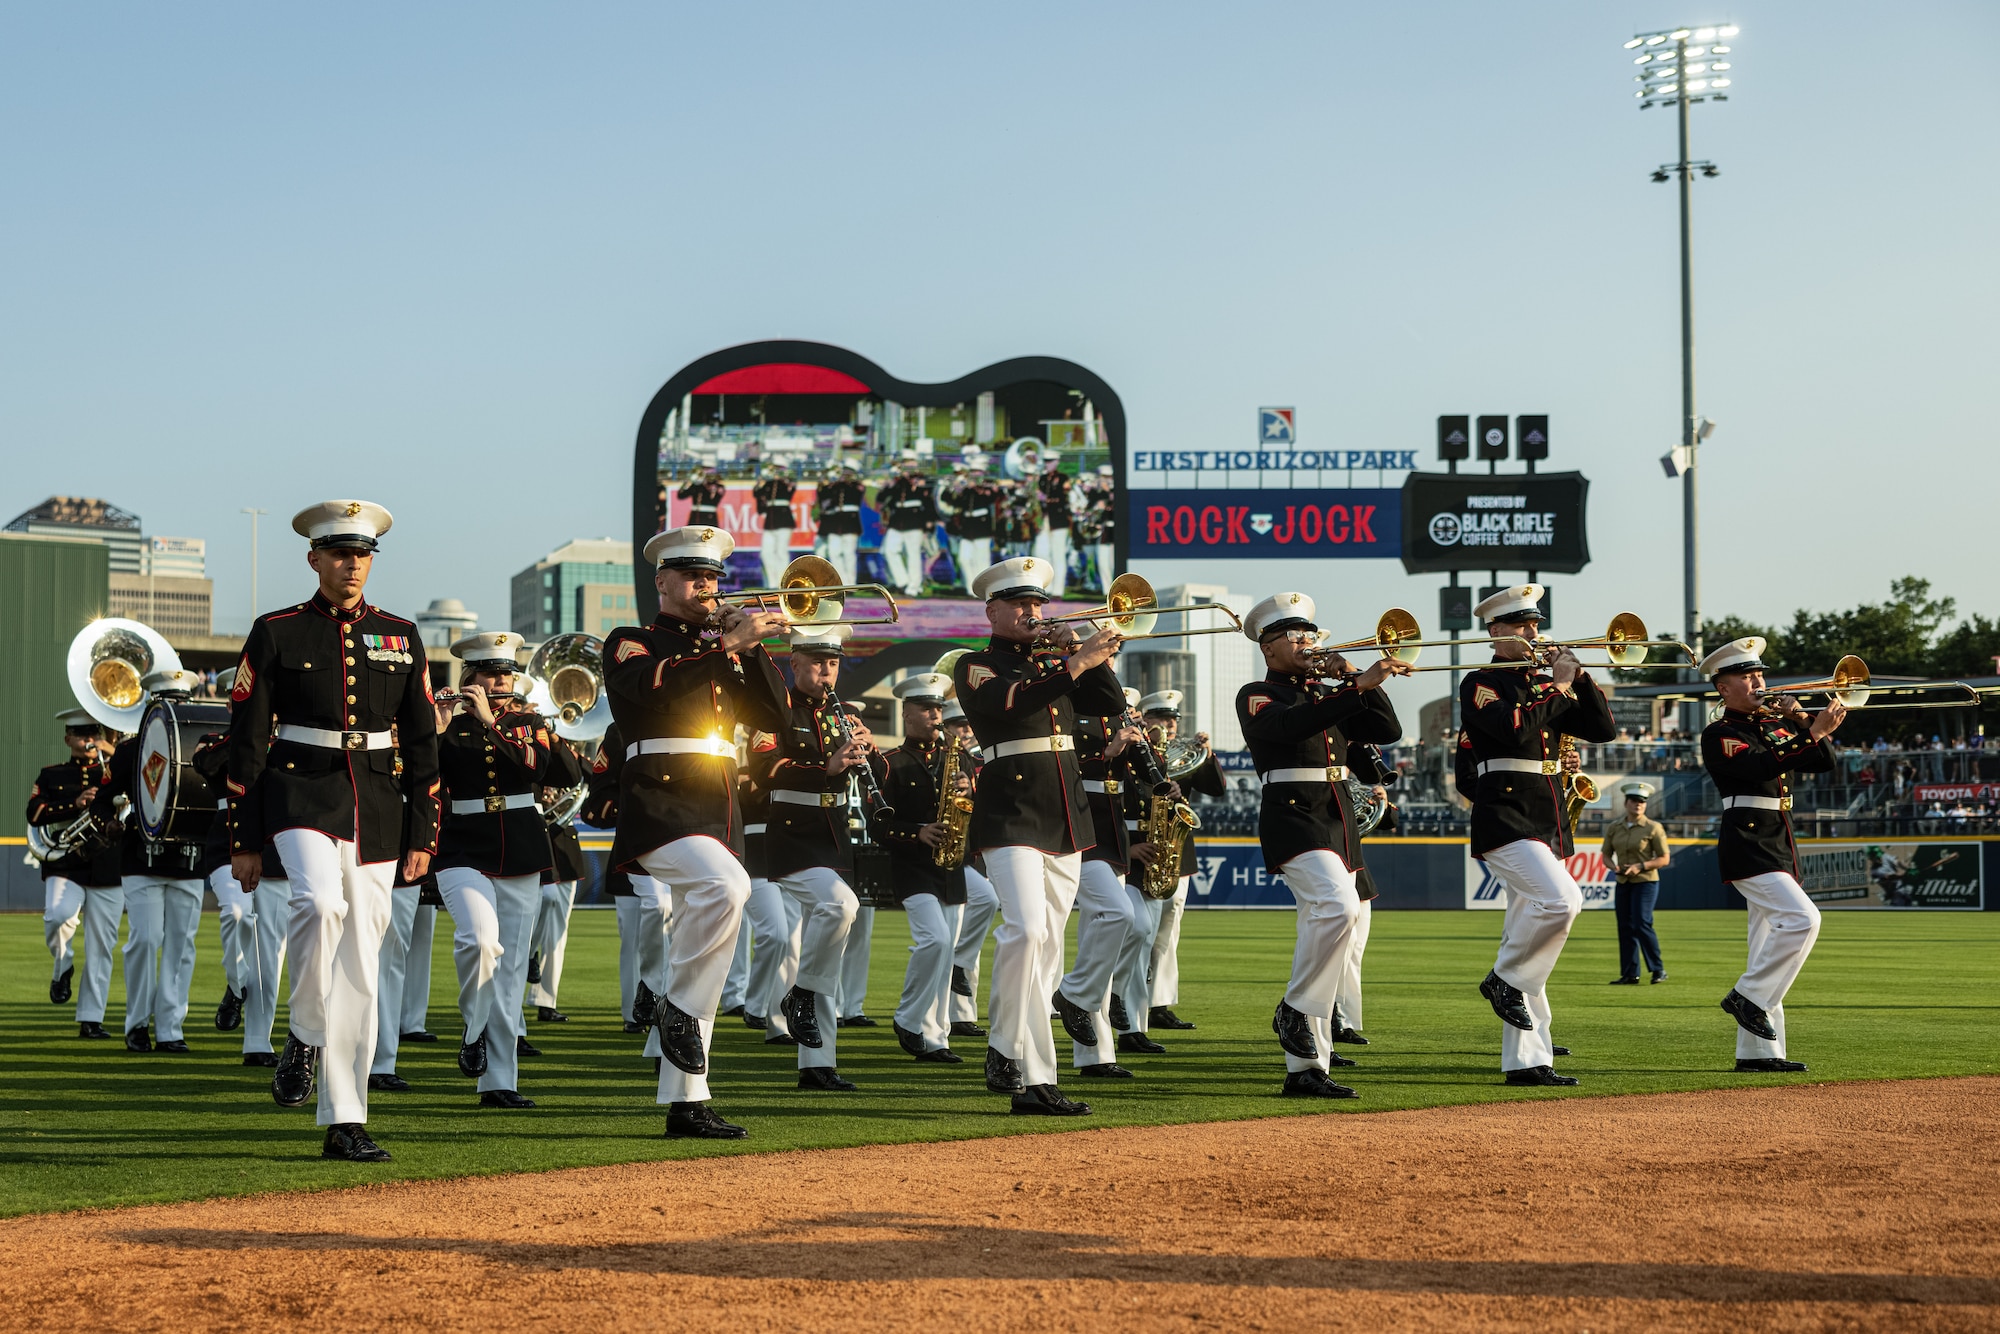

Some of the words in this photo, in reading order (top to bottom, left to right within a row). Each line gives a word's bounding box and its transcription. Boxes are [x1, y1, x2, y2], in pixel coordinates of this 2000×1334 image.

[1134, 451, 1208, 471] FIRST
[1214, 450, 1341, 470] HORIZON
[1349, 450, 1418, 470] PARK
[1467, 496, 1513, 509] PRESENTED
[1514, 496, 1527, 509] BY
[1147, 505, 1250, 544] ROCK
[1273, 504, 1377, 544] JOCK
[1461, 513, 1510, 532] BLACK
[1513, 513, 1554, 532] RIFLE
[1461, 532, 1500, 545] COFFEE
[1502, 532, 1554, 545] COMPANY
[1228, 755, 1240, 766] of
[1920, 788, 1974, 800] TOYOTA
[1565, 851, 1609, 882] OW
[1801, 849, 1867, 876] WINNING
[1580, 885, 1611, 901] TORS
[1922, 878, 1977, 896] Mint
